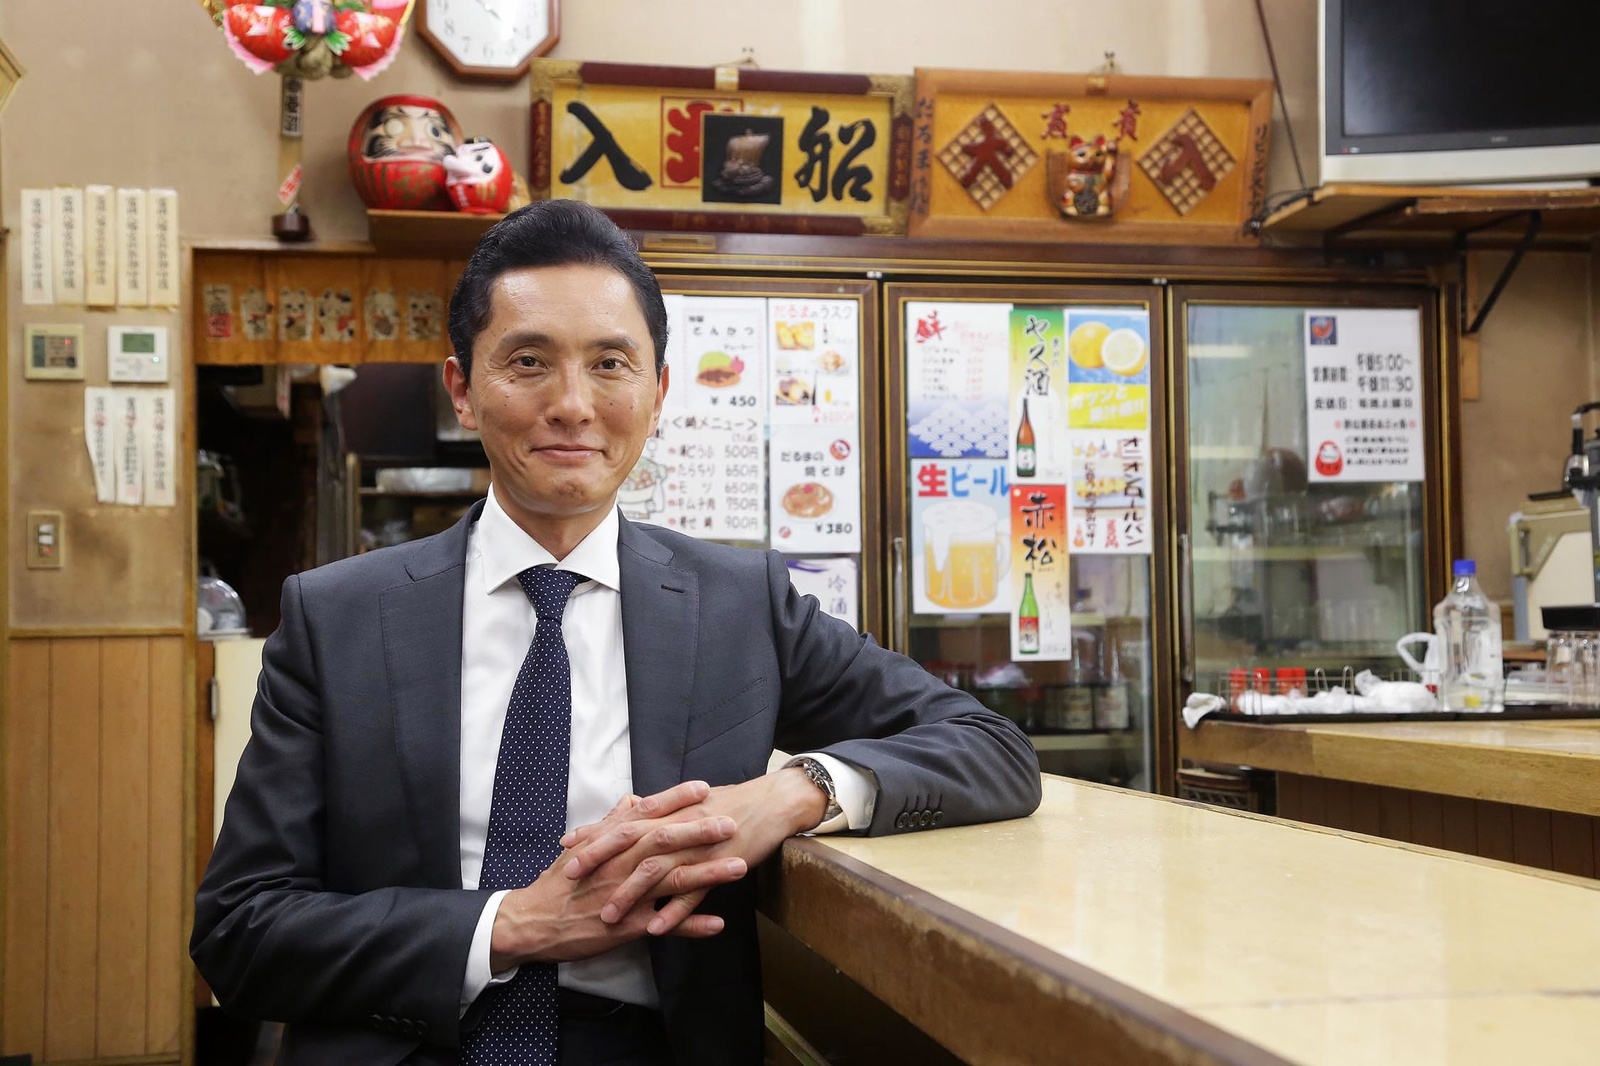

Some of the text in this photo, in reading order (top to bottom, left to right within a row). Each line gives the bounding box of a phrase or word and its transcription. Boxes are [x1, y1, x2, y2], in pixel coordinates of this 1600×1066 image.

[443, 18, 455, 35] 8
[461, 35, 472, 53] 7
[483, 41, 495, 58] 6
[729, 395, 757, 407] 450
[724, 445, 759, 459] 500円
[781, 451, 824, 462] だるまの
[724, 464, 758, 479] 650円
[917, 464, 1010, 497] 生ビール
[724, 482, 758, 496] 650円
[1122, 437, 1145, 547] オニオンロールパン
[725, 497, 759, 512] 750円
[724, 516, 758, 531] 900円
[816, 523, 853, 534] ¥380
[1021, 492, 1057, 571] 赤松
